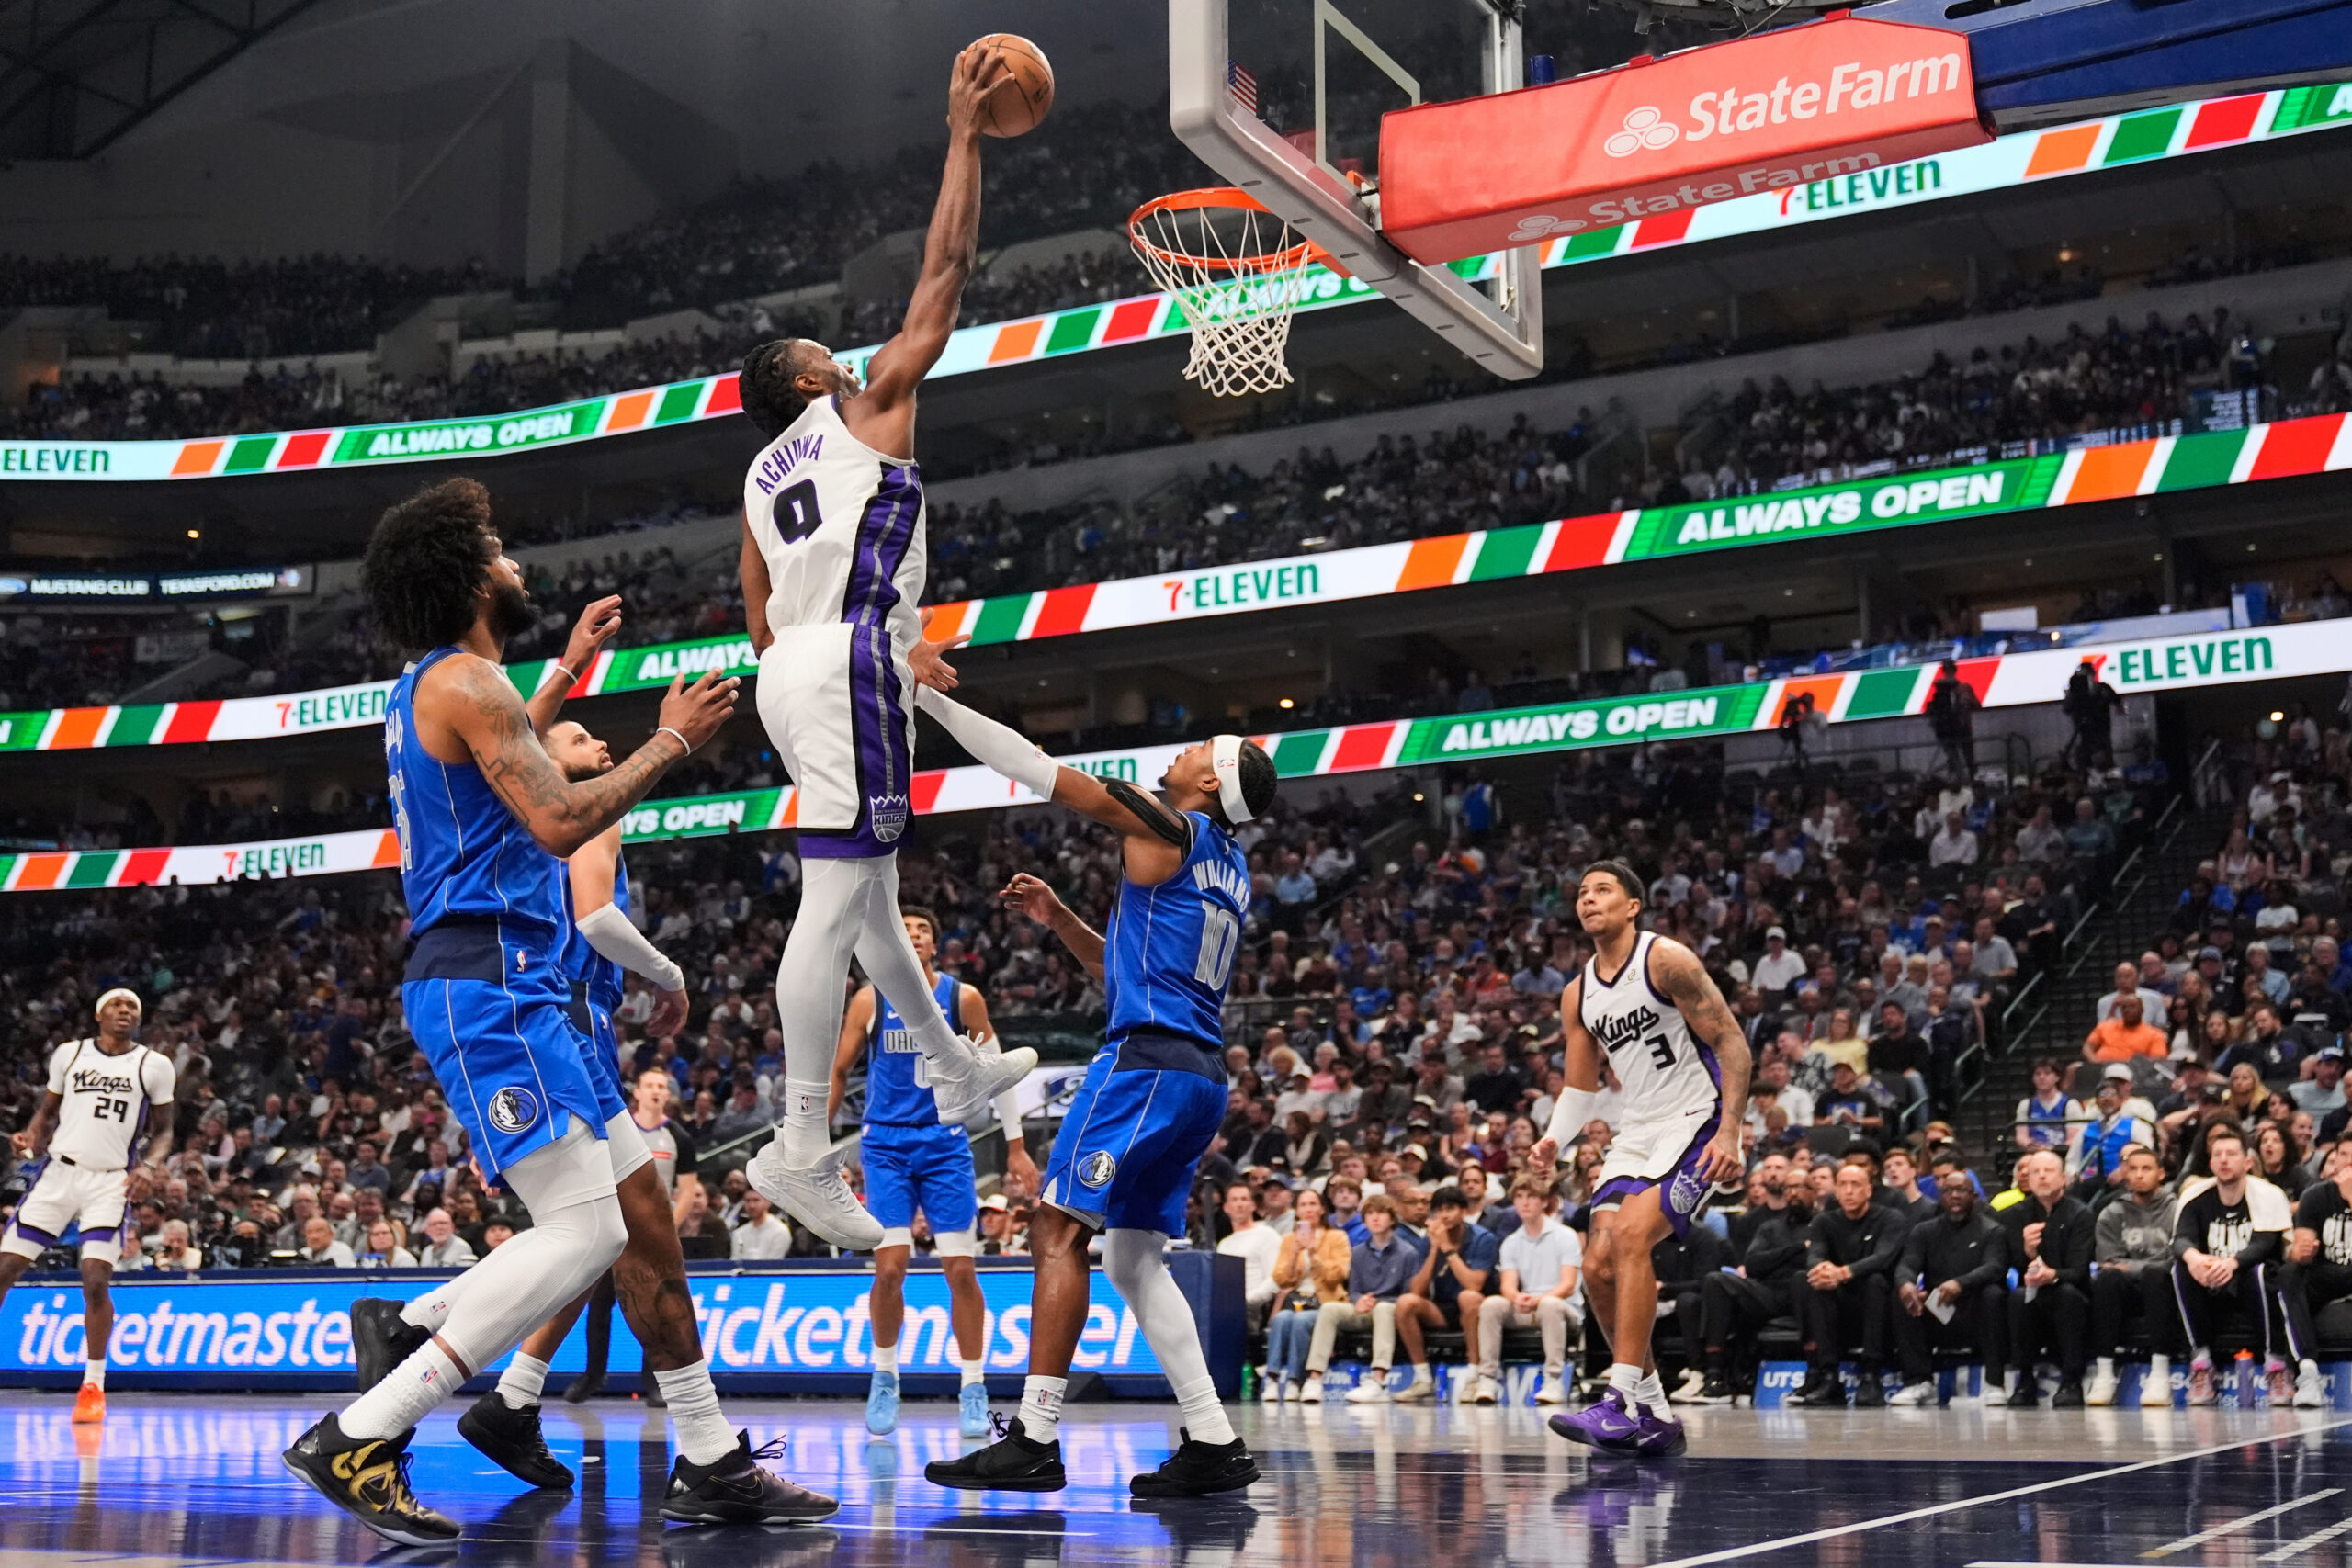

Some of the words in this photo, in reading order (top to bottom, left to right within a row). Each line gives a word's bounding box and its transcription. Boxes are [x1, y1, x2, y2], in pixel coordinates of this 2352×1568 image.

[1588, 182, 1735, 225] State
[1736, 150, 1881, 194] Farm
[368, 425, 493, 456] ALWAYS
[497, 411, 574, 445] OPEN
[756, 434, 823, 495] ACHIUWA
[1677, 491, 1862, 545] ALWAYS
[1871, 471, 2005, 518] OPEN
[30, 579, 107, 595] MUSTANG
[107, 579, 150, 595] CLUB
[637, 641, 760, 681] ALWAYS
[1442, 709, 1600, 751] ALWAYS
[1606, 696, 1718, 735] OPEN
[663, 800, 746, 831] OPEN
[1194, 900, 1238, 991] 10
[1591, 1005, 1660, 1052] Kings
[1645, 1033, 1677, 1071] 3
[73, 1070, 132, 1094] Kings
[94, 1096, 128, 1123] 29
[19, 1294, 356, 1366] ticetmaste
[692, 1283, 1139, 1368] ticketmaser
